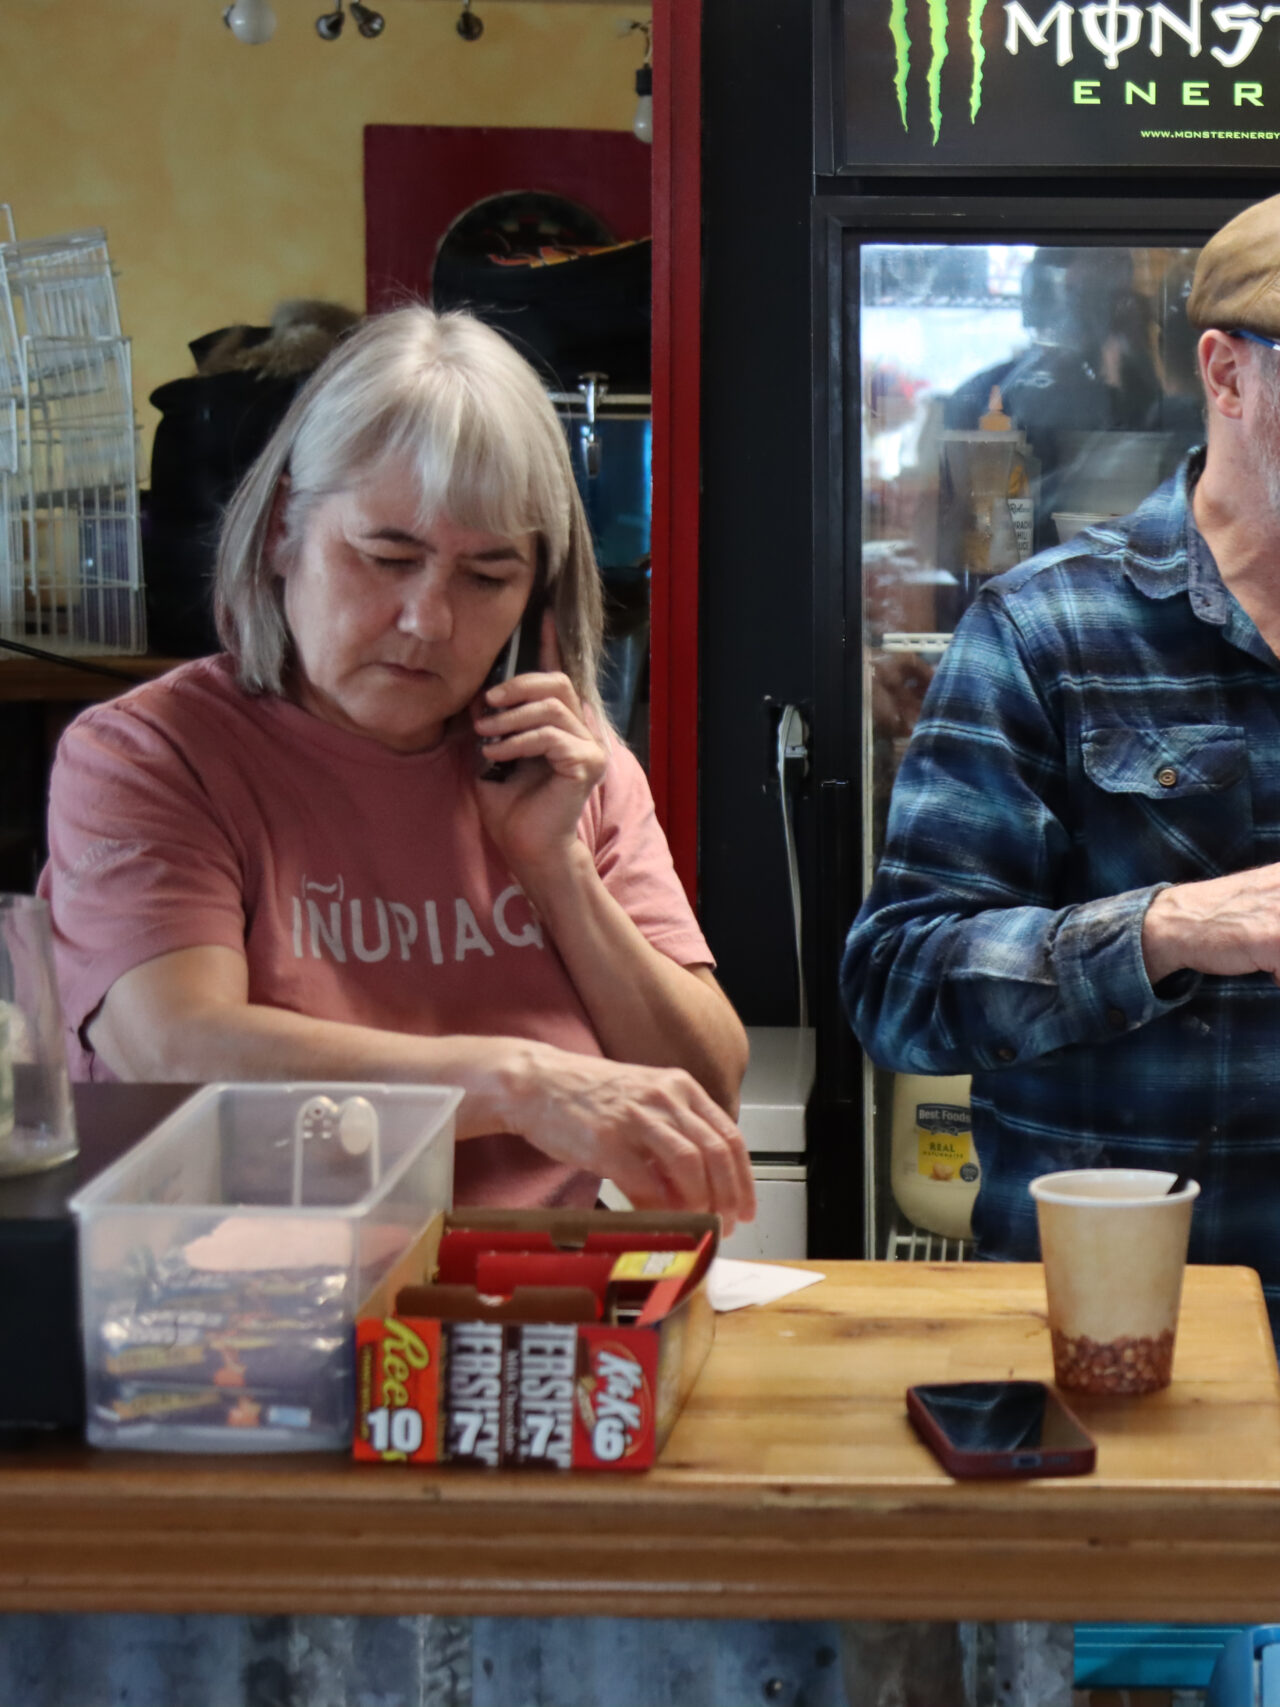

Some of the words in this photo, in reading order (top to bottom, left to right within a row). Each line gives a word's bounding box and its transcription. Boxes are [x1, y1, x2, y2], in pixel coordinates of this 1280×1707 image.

[919, 1109, 940, 1120] Best
[929, 1142, 956, 1153] REAL
[367, 1408, 423, 1453] 10
[454, 1412, 485, 1455] 7
[525, 1415, 556, 1457] 7
[593, 1417, 626, 1461] 6
